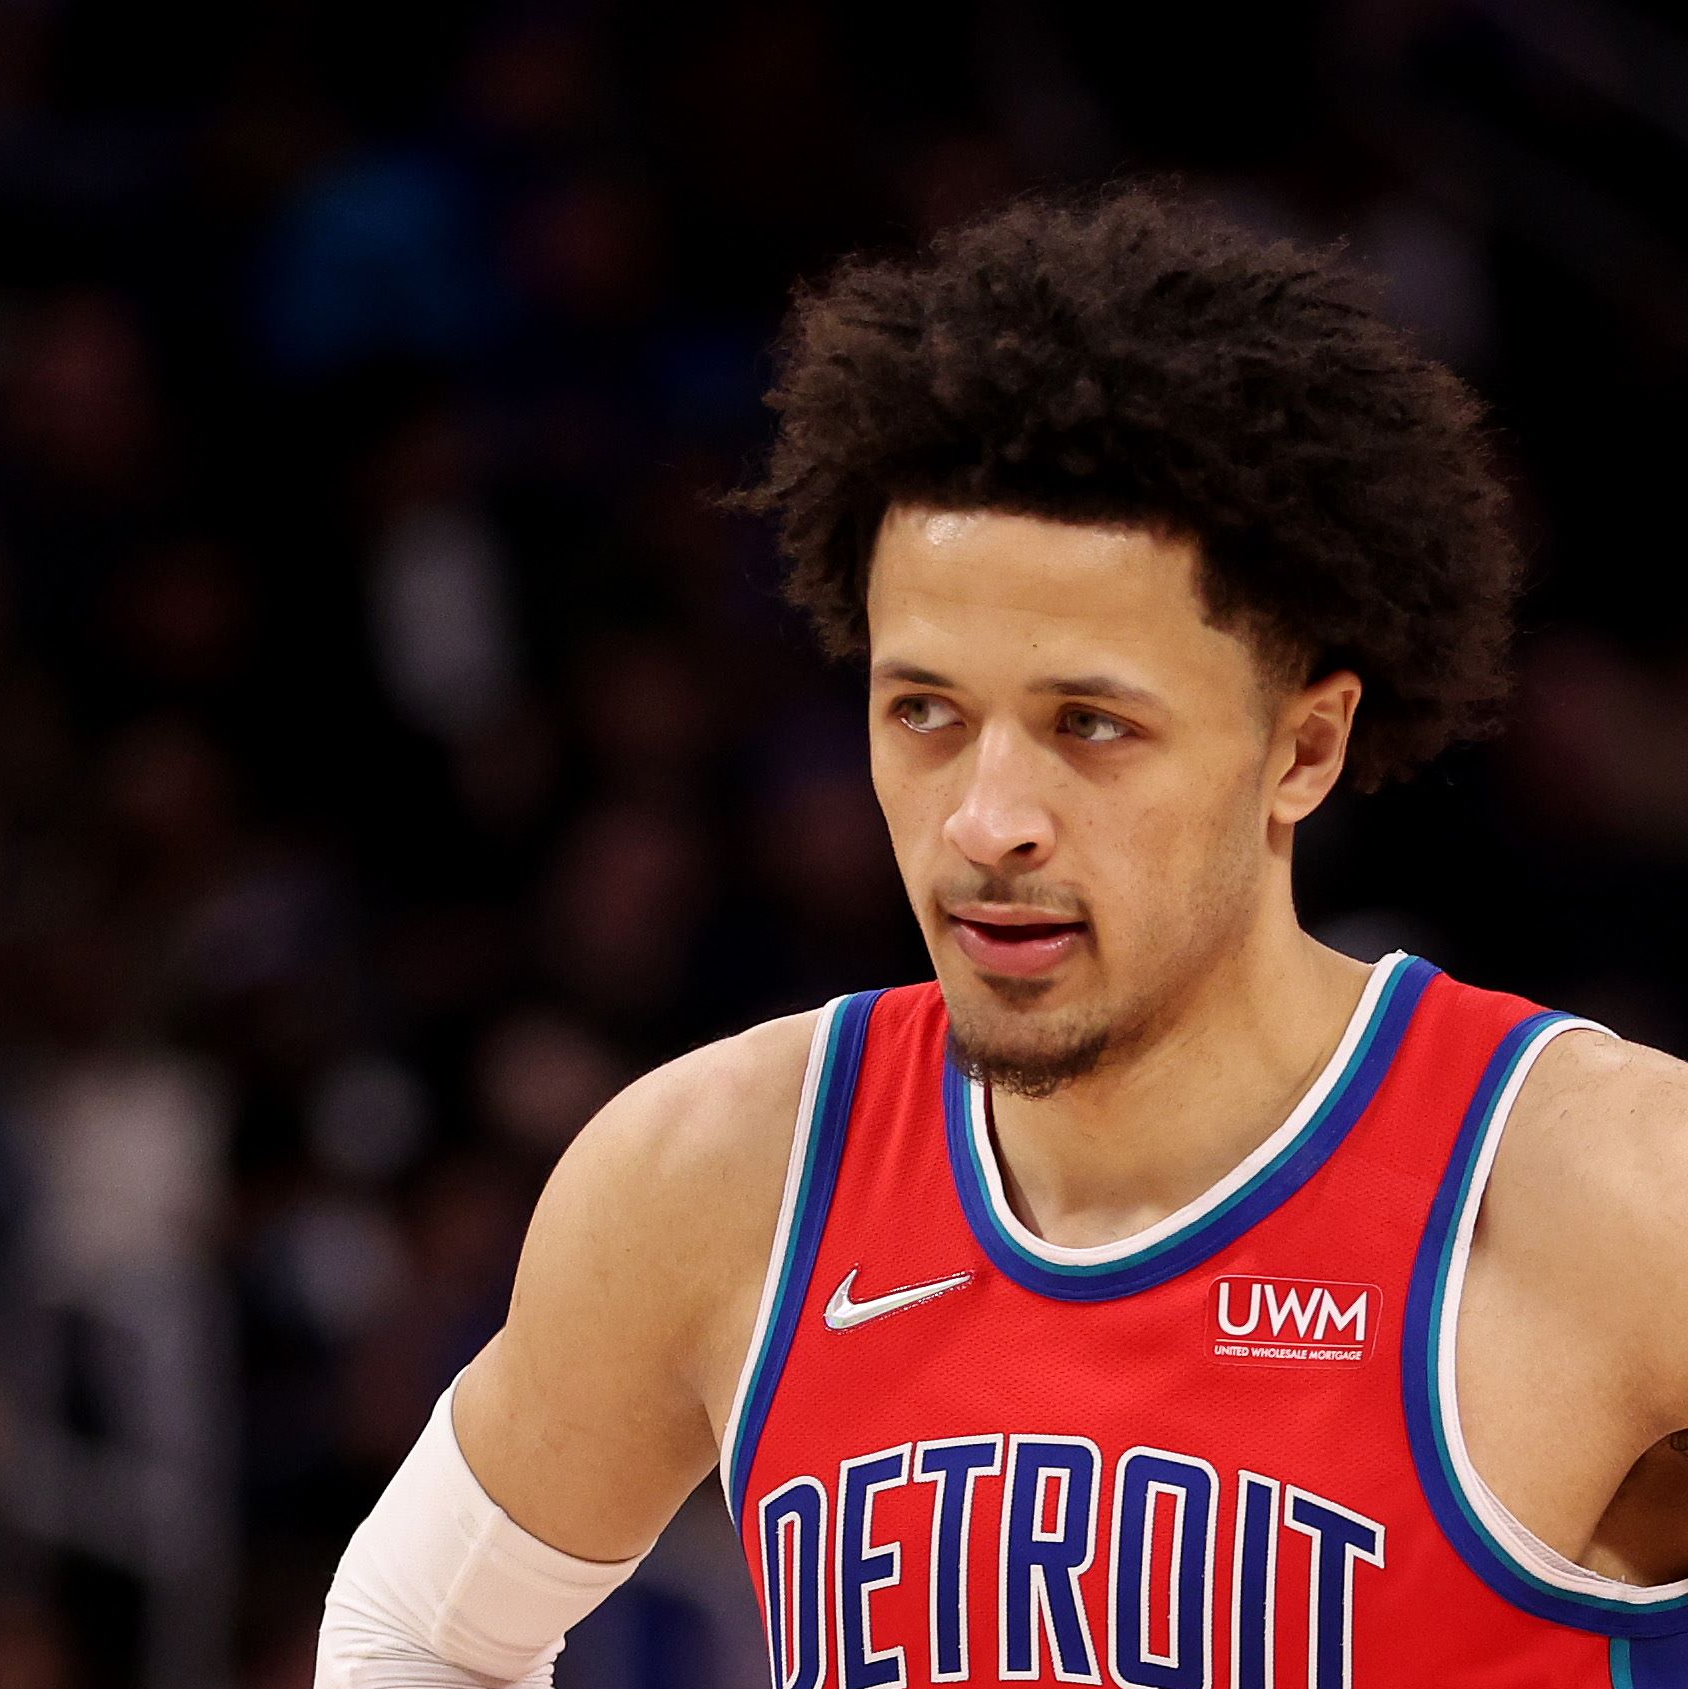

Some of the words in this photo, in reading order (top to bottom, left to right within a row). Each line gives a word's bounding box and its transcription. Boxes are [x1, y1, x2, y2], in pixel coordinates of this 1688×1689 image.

[1218, 1282, 1367, 1341] UWM
[1214, 1345, 1249, 1357] UNITED
[1251, 1347, 1307, 1360] WHOLESALE
[1309, 1350, 1363, 1361] MORTGAGE
